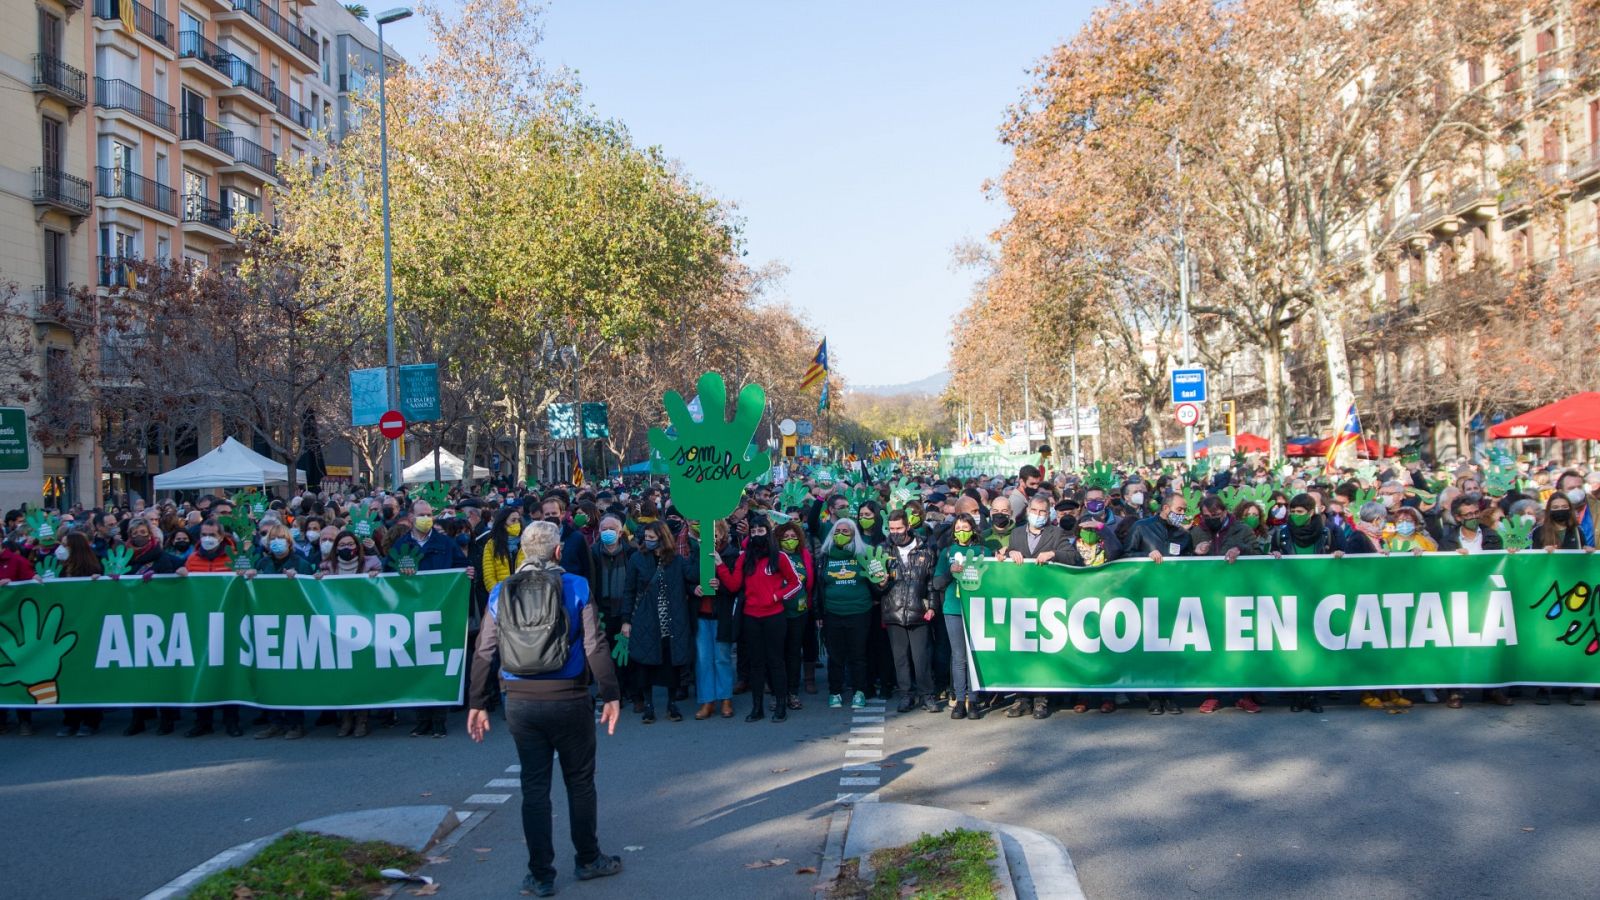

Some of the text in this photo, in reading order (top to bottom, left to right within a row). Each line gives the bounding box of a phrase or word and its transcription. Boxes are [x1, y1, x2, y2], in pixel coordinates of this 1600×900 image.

[1180, 410, 1194, 418] 30
[670, 445, 722, 466] som
[682, 450, 752, 483] escola
[969, 574, 1518, 653] L'ESCOLA EN CATALÀ
[95, 610, 464, 676] ARA I SEMPRE,
